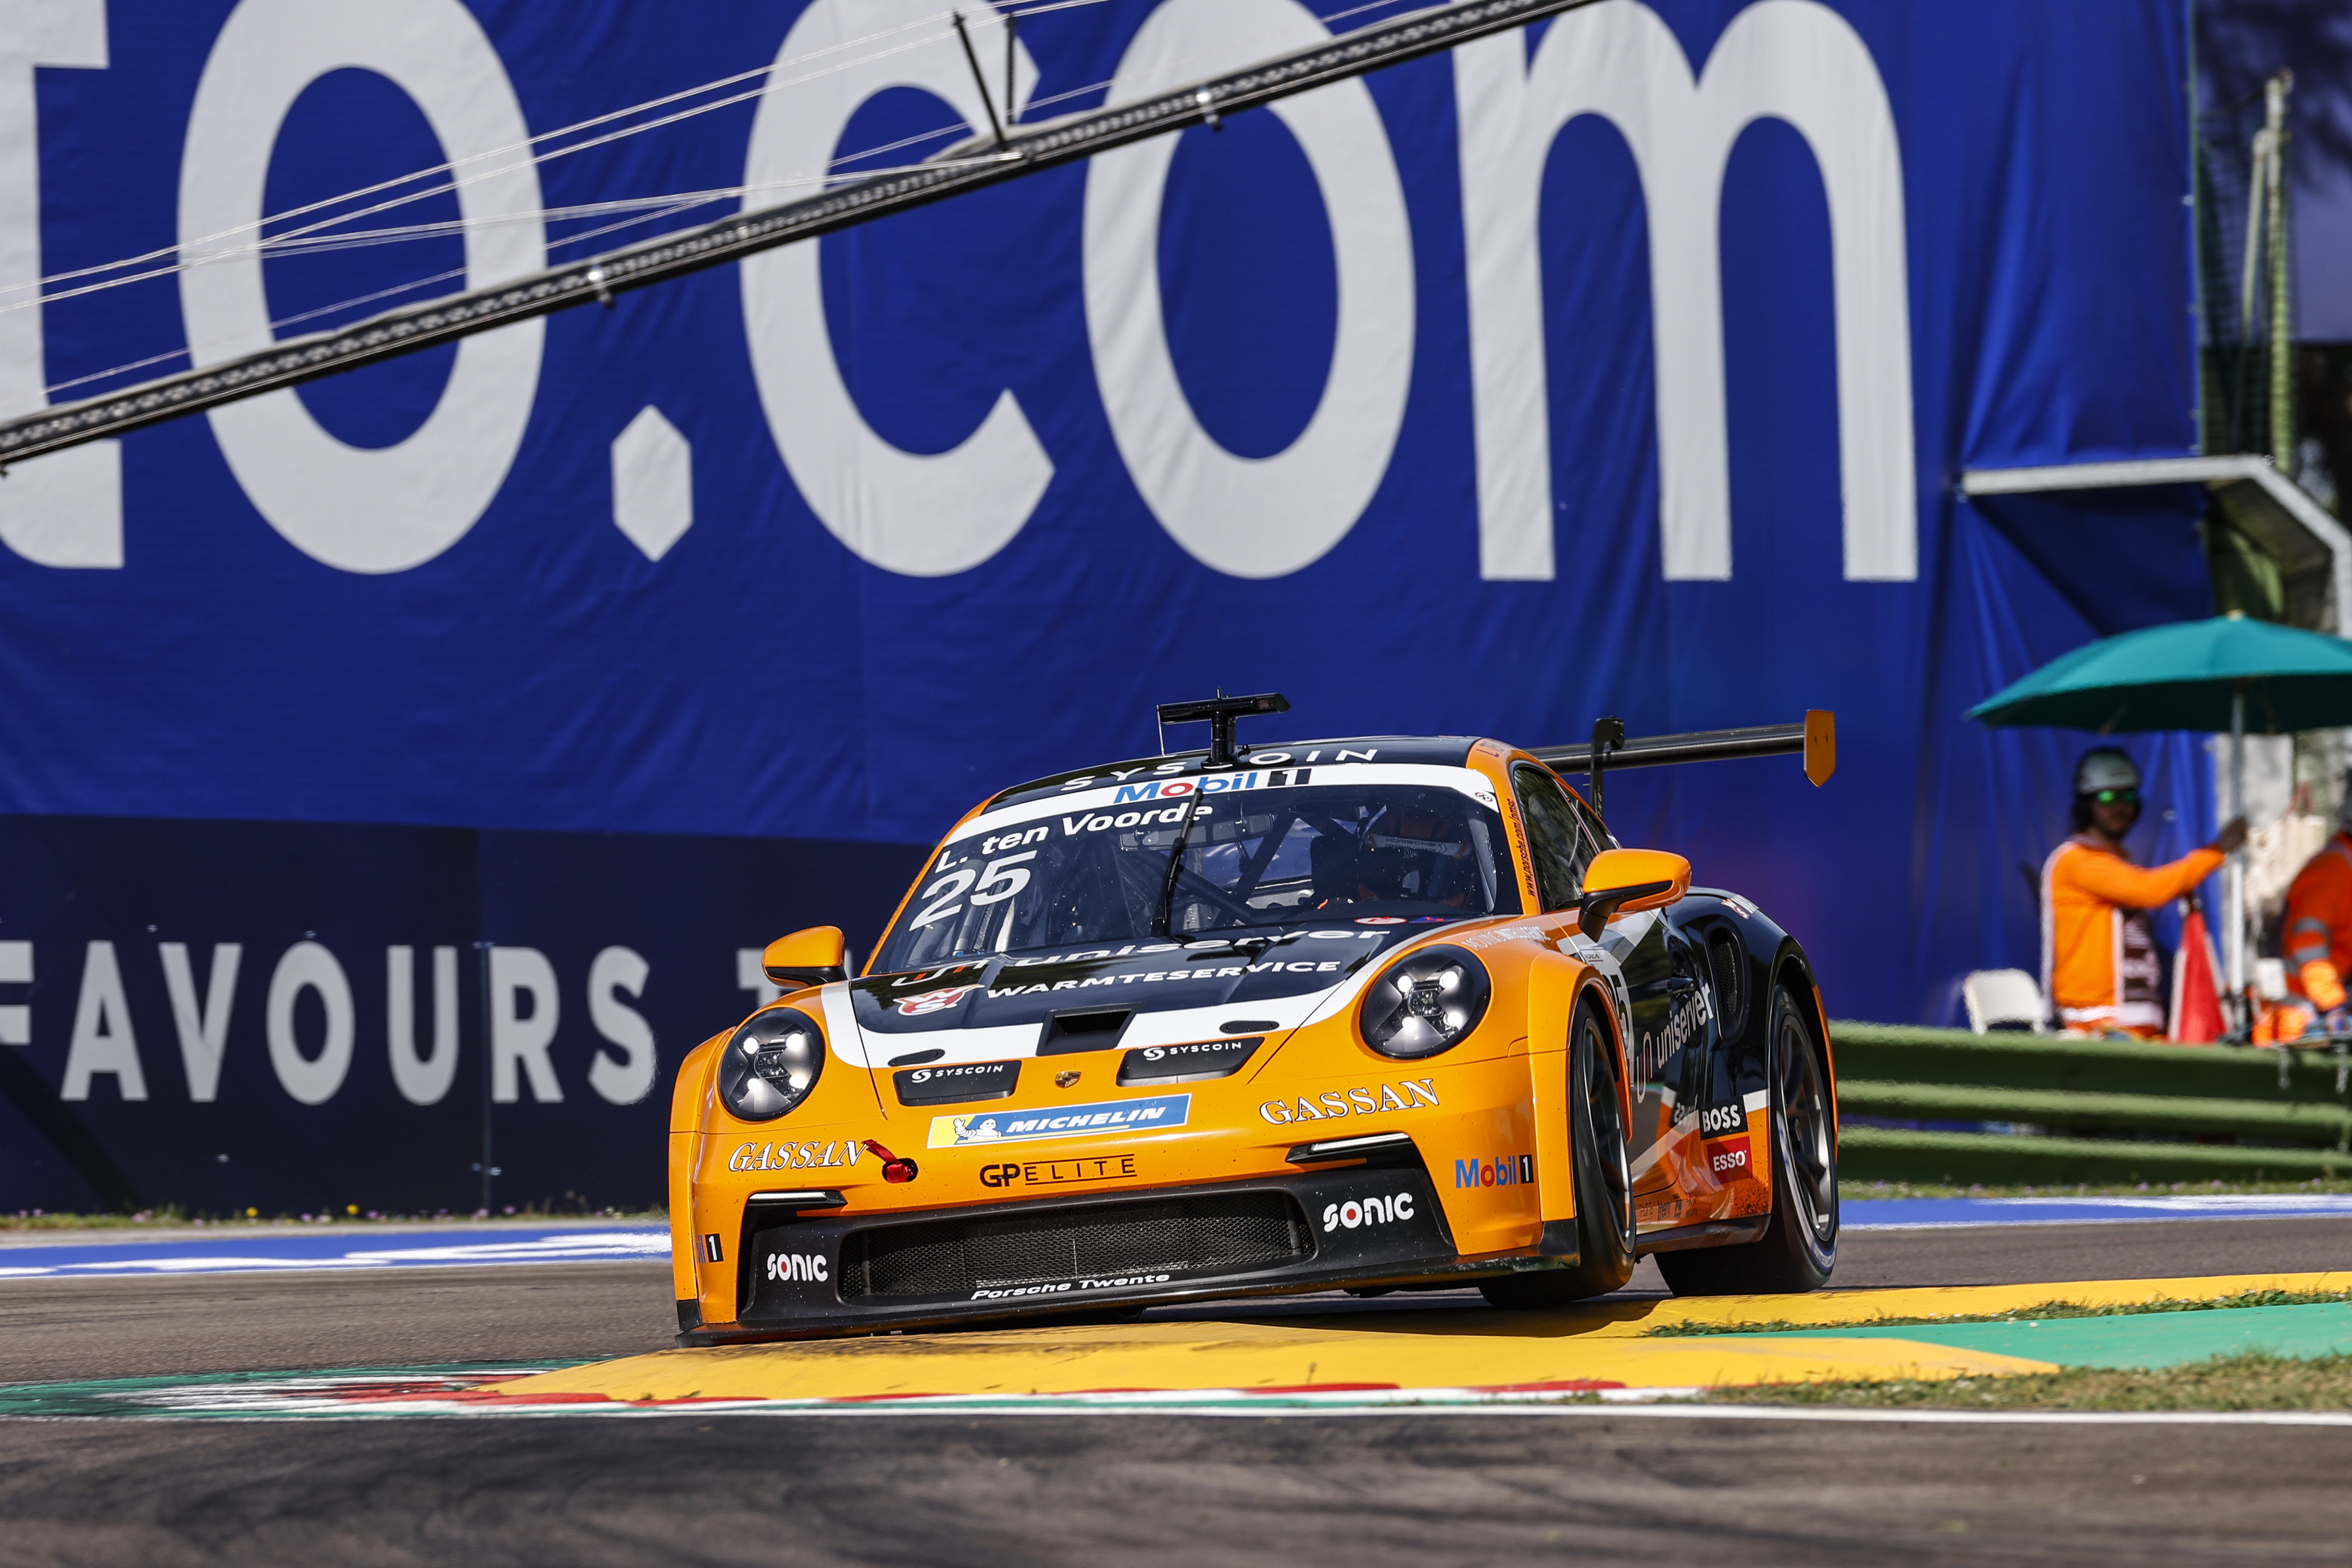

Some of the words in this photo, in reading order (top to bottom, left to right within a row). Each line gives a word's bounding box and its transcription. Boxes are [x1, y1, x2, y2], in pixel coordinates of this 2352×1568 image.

[1060, 749, 1378, 791] SYSOIN
[1113, 772, 1258, 804] Mobil
[935, 851, 968, 873] L.
[982, 826, 1049, 855] ten
[1062, 802, 1213, 836] Voorde
[909, 849, 1038, 932] 25
[1014, 930, 1391, 966] uniserver
[987, 961, 1341, 998] WARMTESERVICE
[1657, 982, 1714, 1069] uniserver
[1170, 1042, 1242, 1055] SYSCOIN
[935, 1065, 1004, 1078] SYSCOIN
[1259, 1078, 1440, 1125] GASSAN
[1006, 1106, 1167, 1133] MICHELIN
[1702, 1104, 1741, 1133] BOSS
[728, 1140, 868, 1173] GASSAN
[1455, 1155, 1517, 1189] Mobil
[1713, 1150, 1746, 1172] ESSO
[970, 1282, 1071, 1300] Porsche
[1079, 1273, 1170, 1289] Twente
